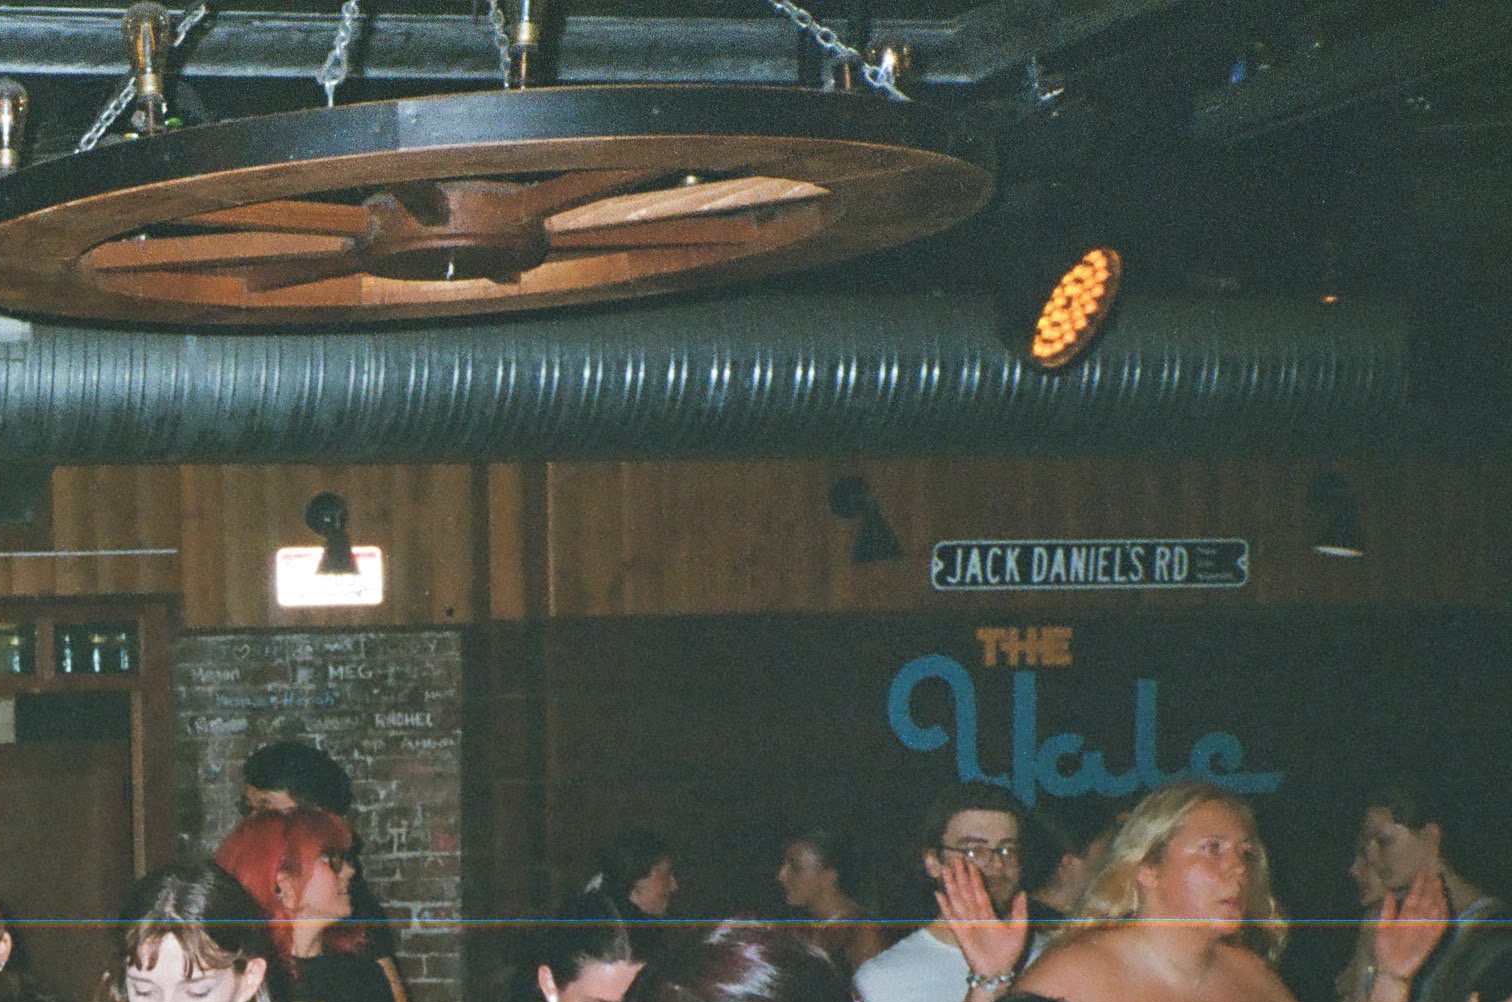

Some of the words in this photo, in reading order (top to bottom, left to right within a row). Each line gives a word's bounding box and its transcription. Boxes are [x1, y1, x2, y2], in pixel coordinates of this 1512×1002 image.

[946, 547, 1021, 584] JACK
[1031, 546, 1145, 583] DANIEL'S
[1154, 545, 1188, 582] RD
[976, 626, 1073, 668] THE
[328, 665, 373, 680] MEG
[889, 653, 1284, 811] Yale
